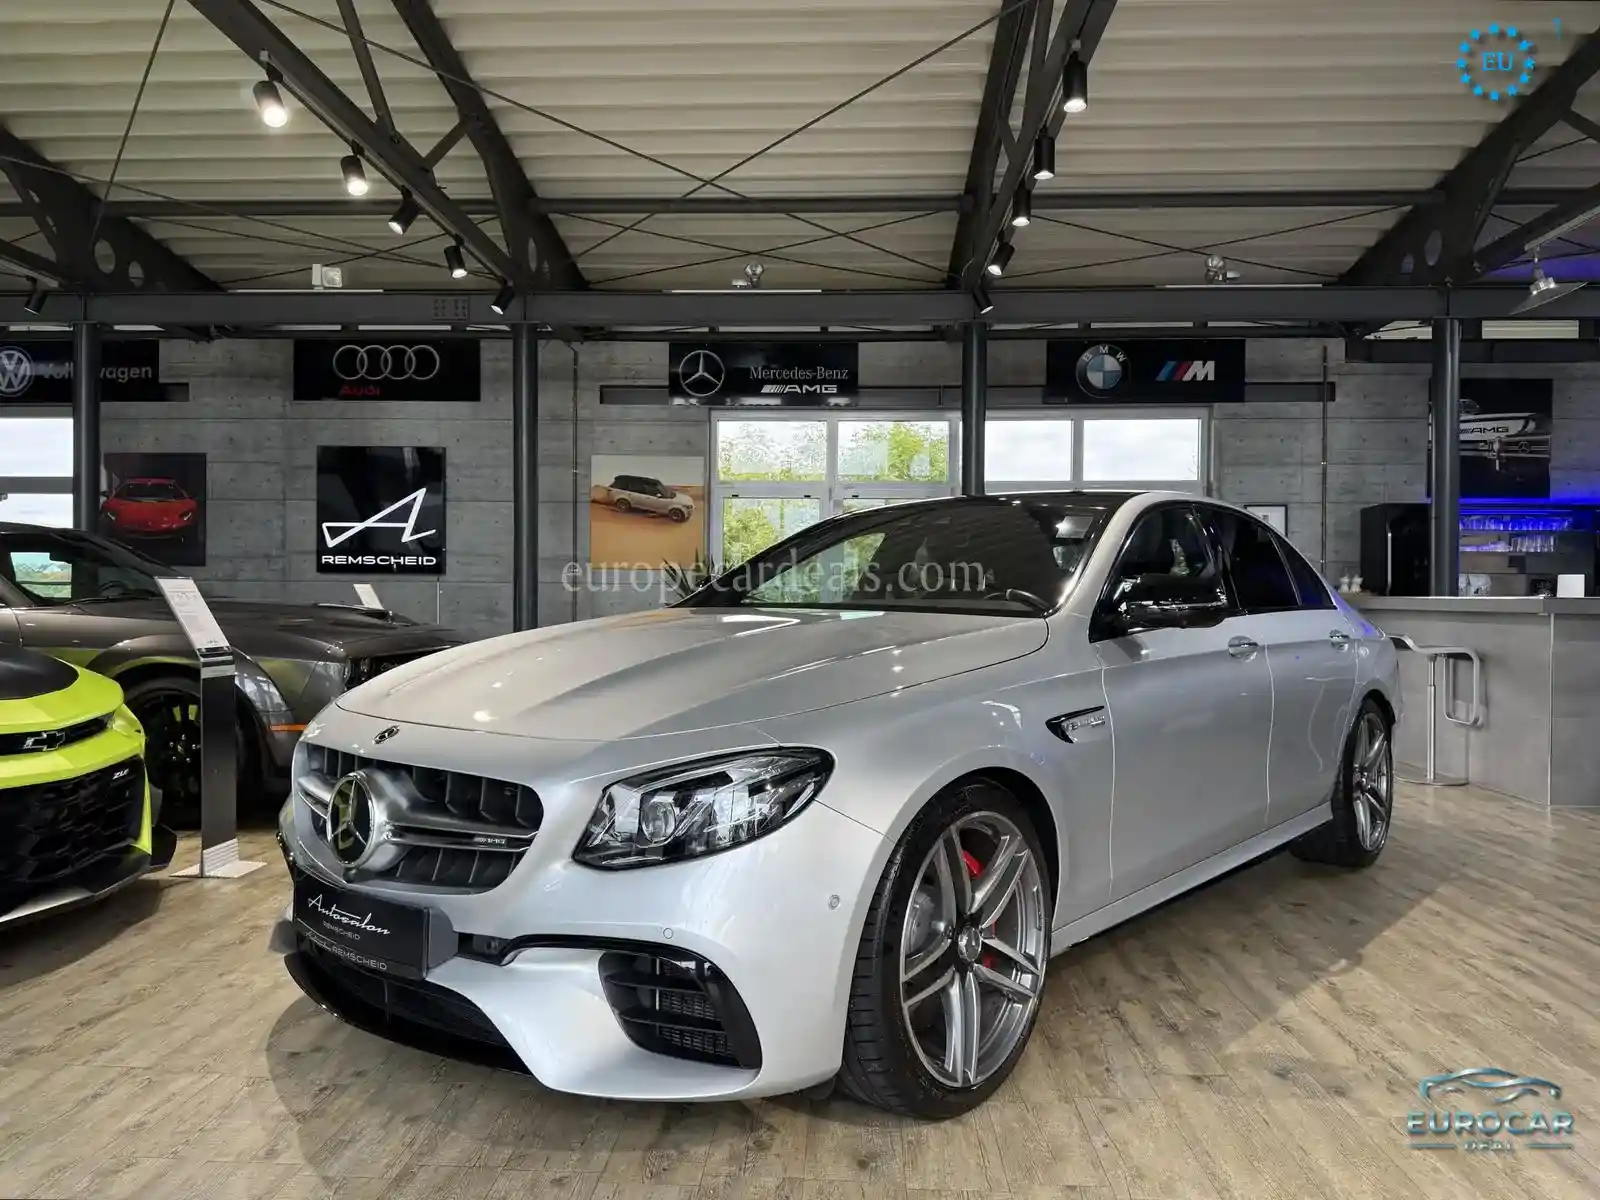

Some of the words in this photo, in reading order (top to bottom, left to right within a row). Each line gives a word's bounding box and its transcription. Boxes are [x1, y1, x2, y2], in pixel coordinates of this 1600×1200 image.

[749, 366, 849, 380] Mercedes-Benz
[783, 384, 838, 394] AMG
[1470, 426, 1509, 434] AMG
[321, 555, 437, 566] REMSCHEID
[307, 894, 391, 935] Autosalon
[331, 946, 388, 972] REMSCHEID
